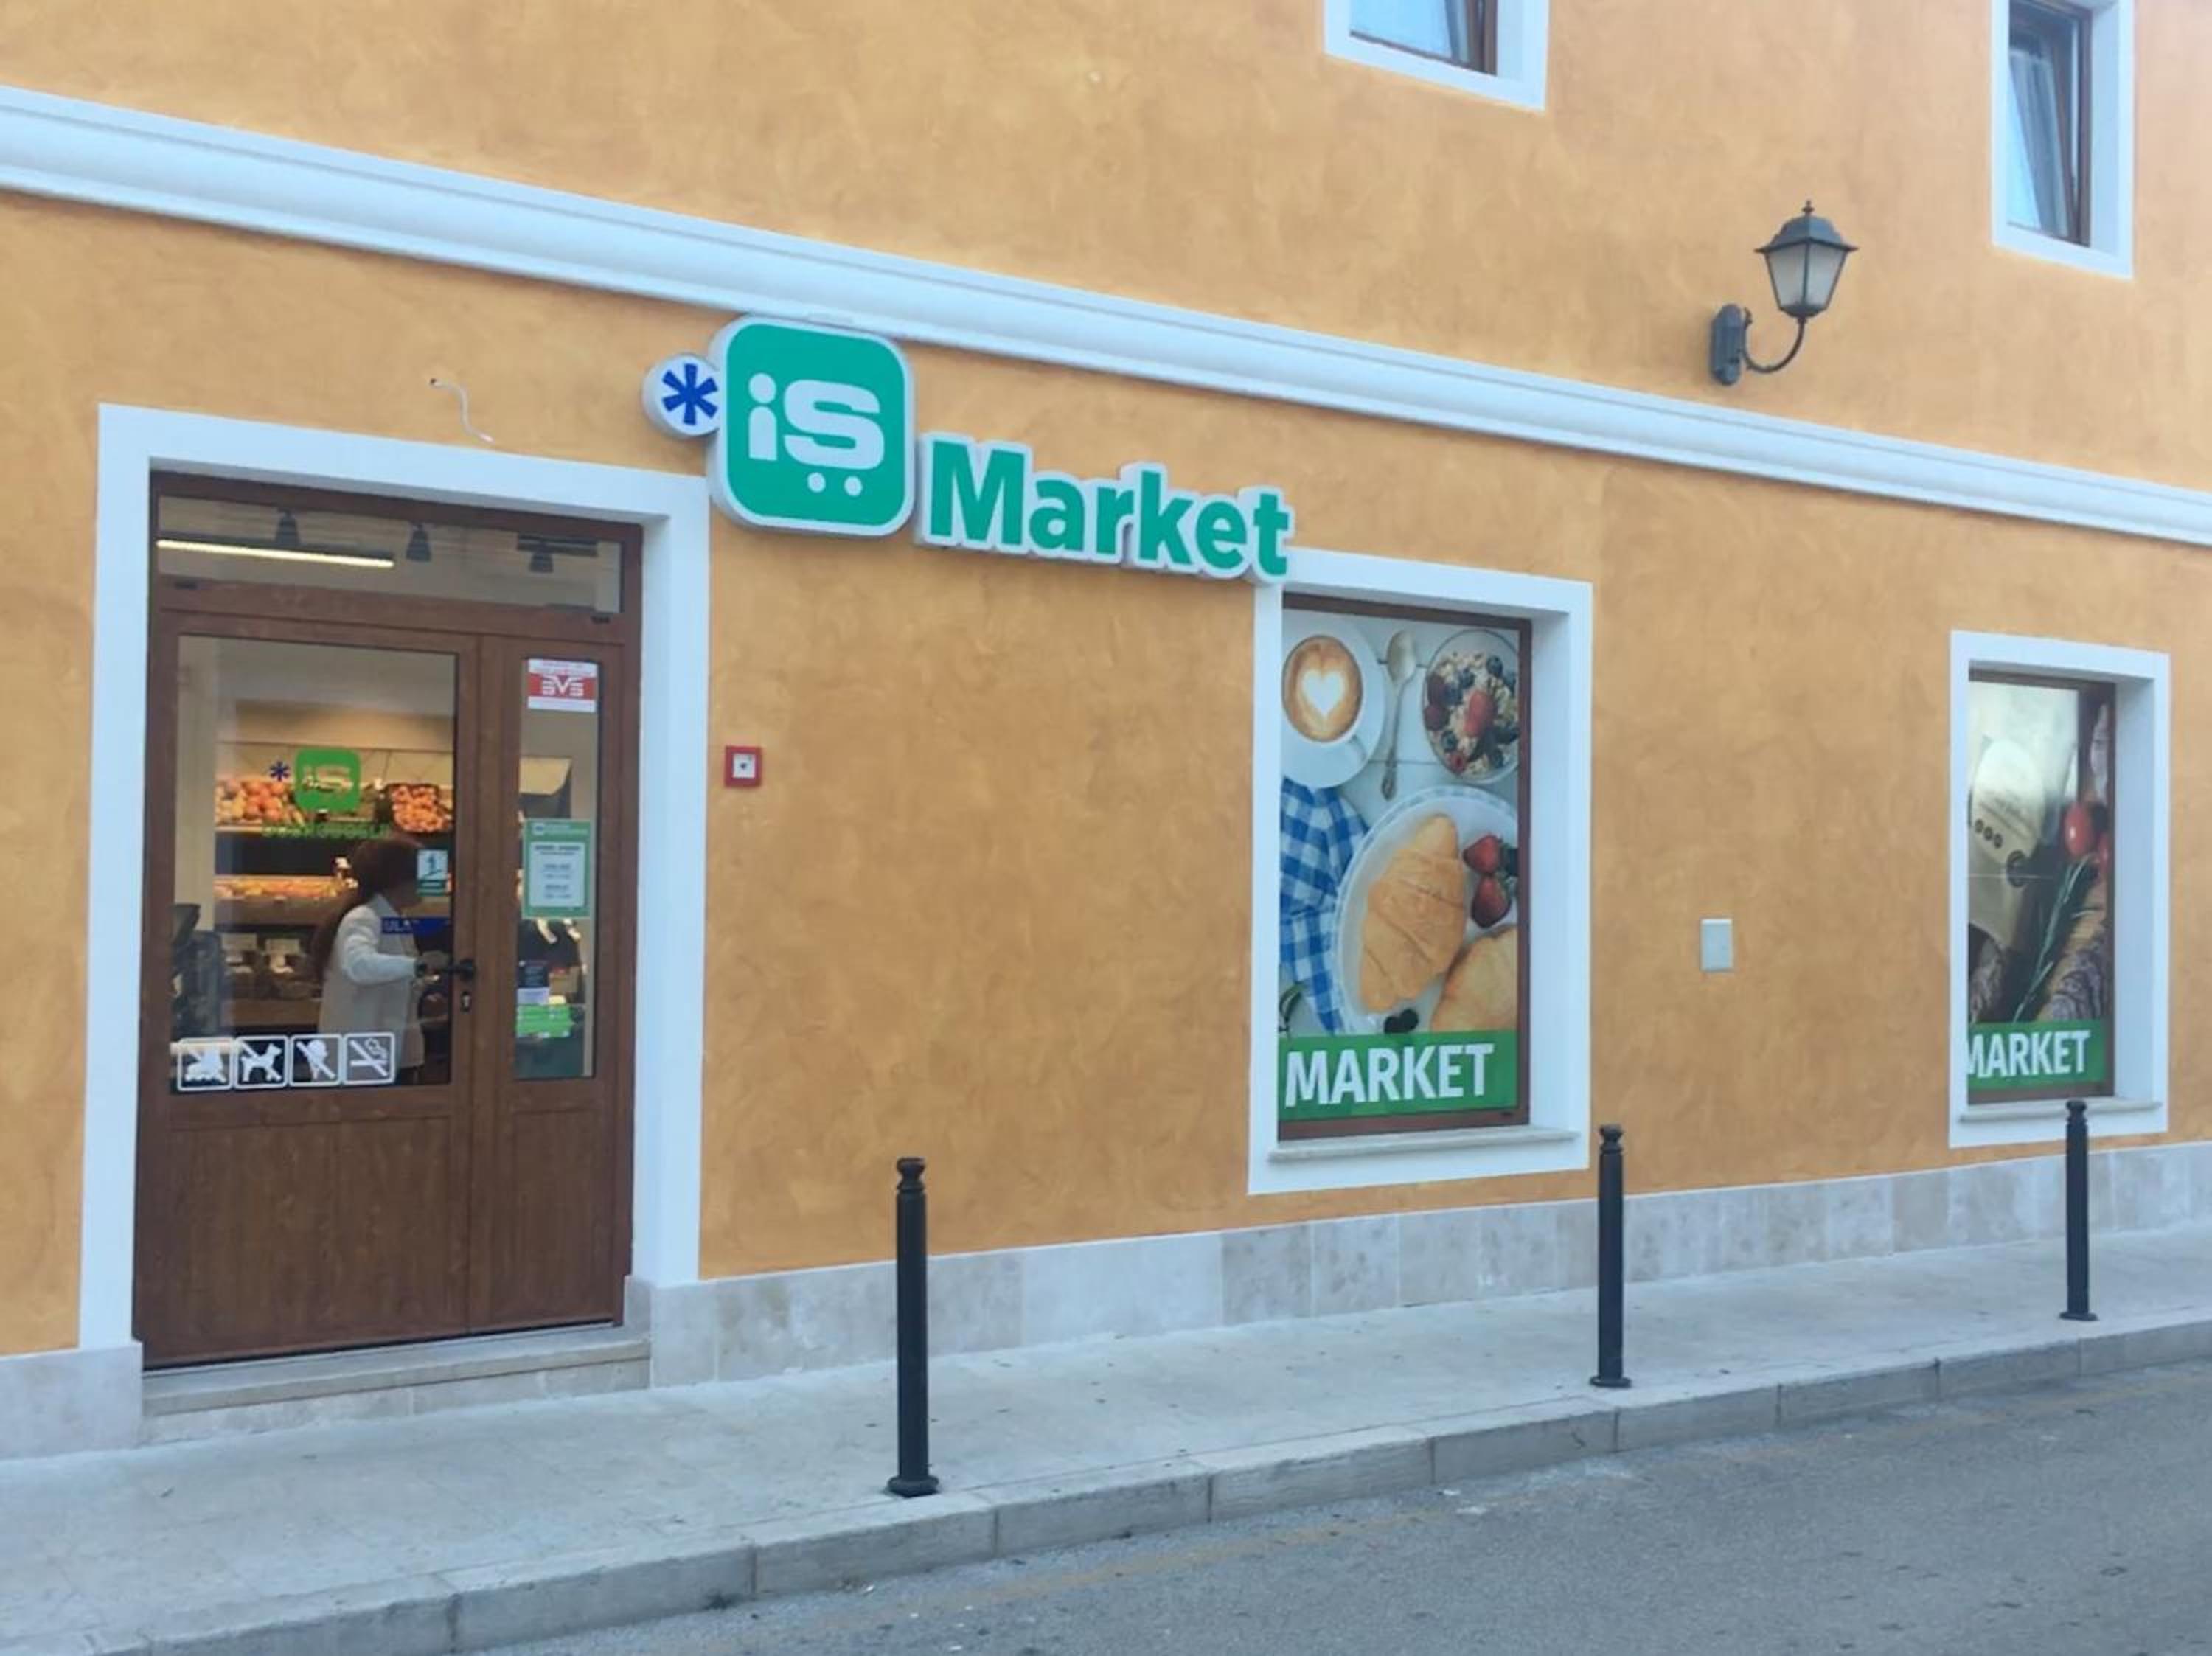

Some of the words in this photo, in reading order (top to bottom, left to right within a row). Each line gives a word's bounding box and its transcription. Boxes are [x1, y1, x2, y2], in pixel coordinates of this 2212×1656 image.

[930, 440, 1290, 576] Market
[1285, 1043, 1495, 1107] MARKET
[1966, 1029, 2091, 1078] MARKET
